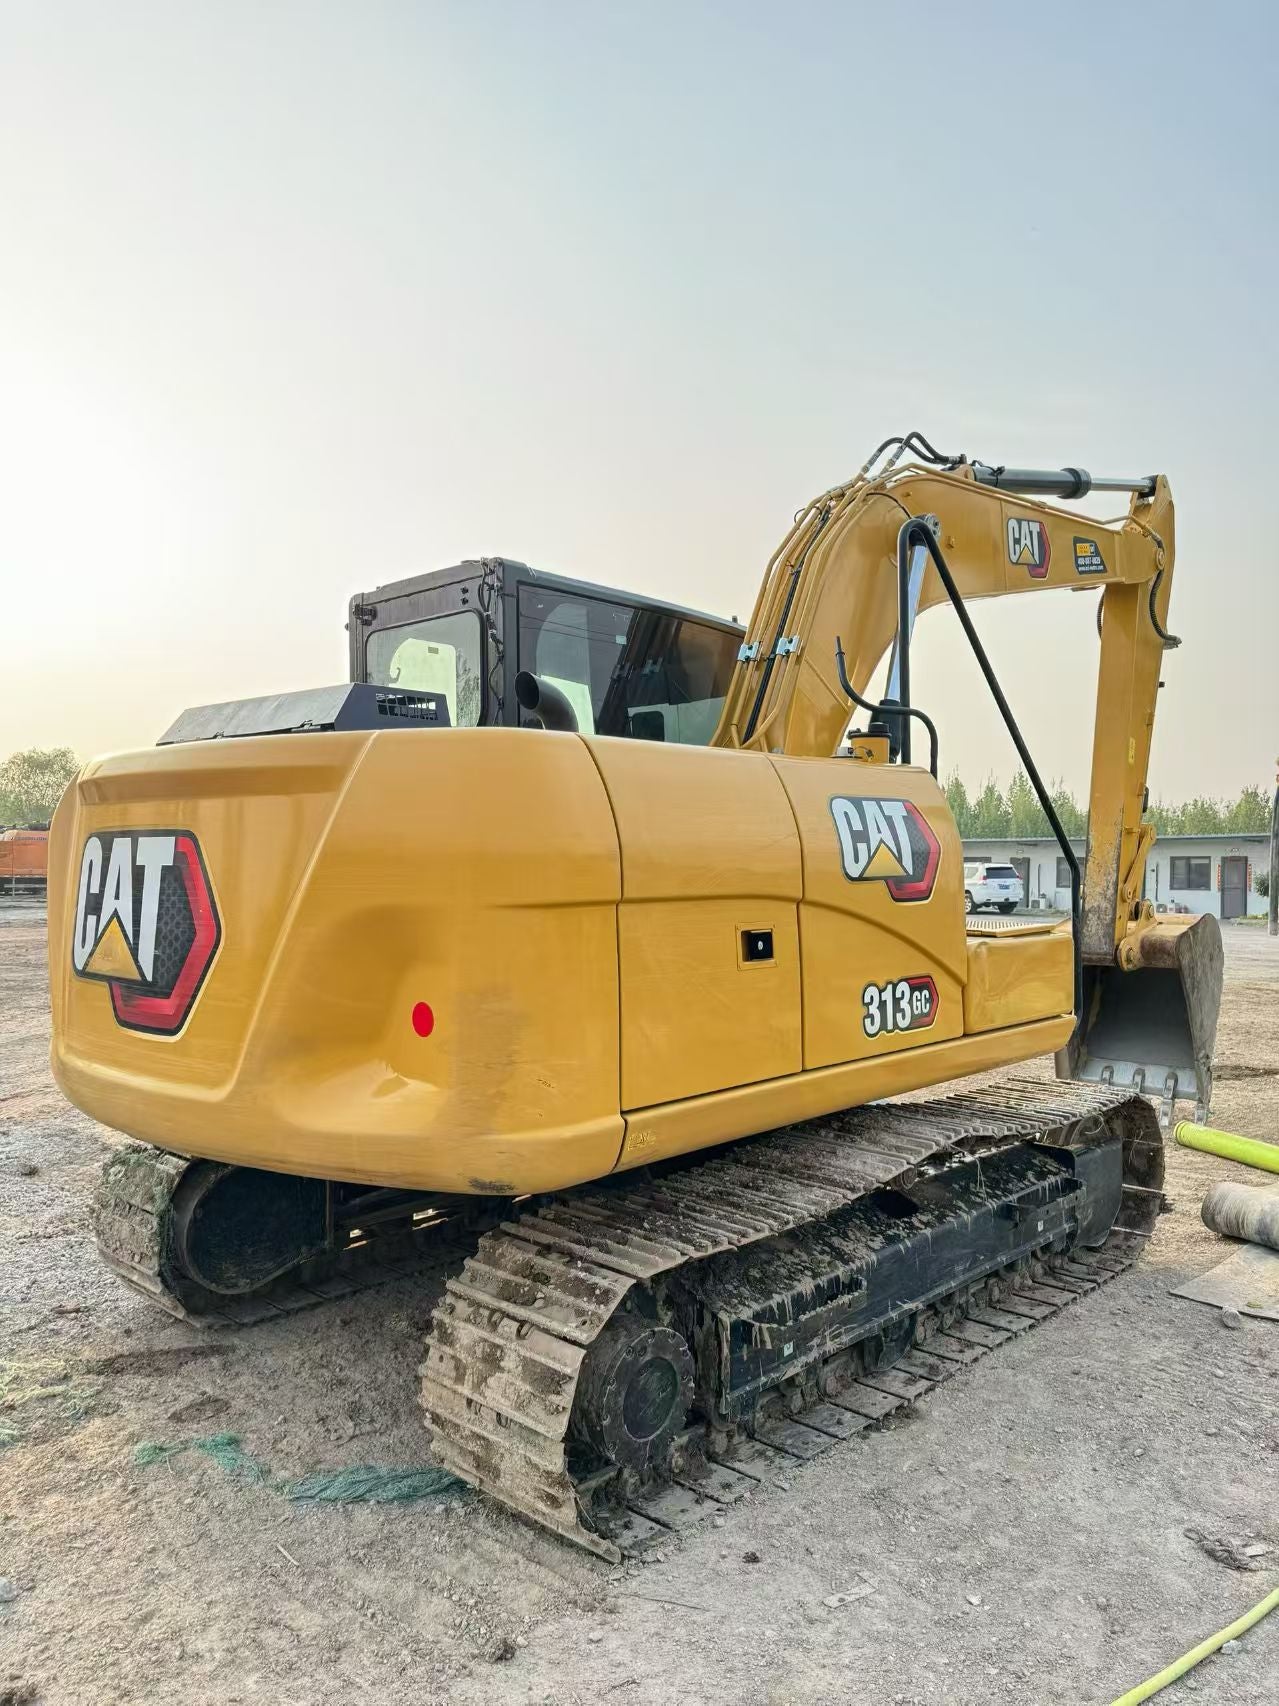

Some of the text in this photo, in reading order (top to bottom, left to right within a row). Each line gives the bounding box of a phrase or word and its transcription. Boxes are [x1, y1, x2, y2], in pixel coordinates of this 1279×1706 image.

[1008, 519, 1040, 565] CAT
[831, 798, 913, 878] CAT
[73, 836, 176, 982] CAT
[863, 981, 930, 1035] 313 GC
